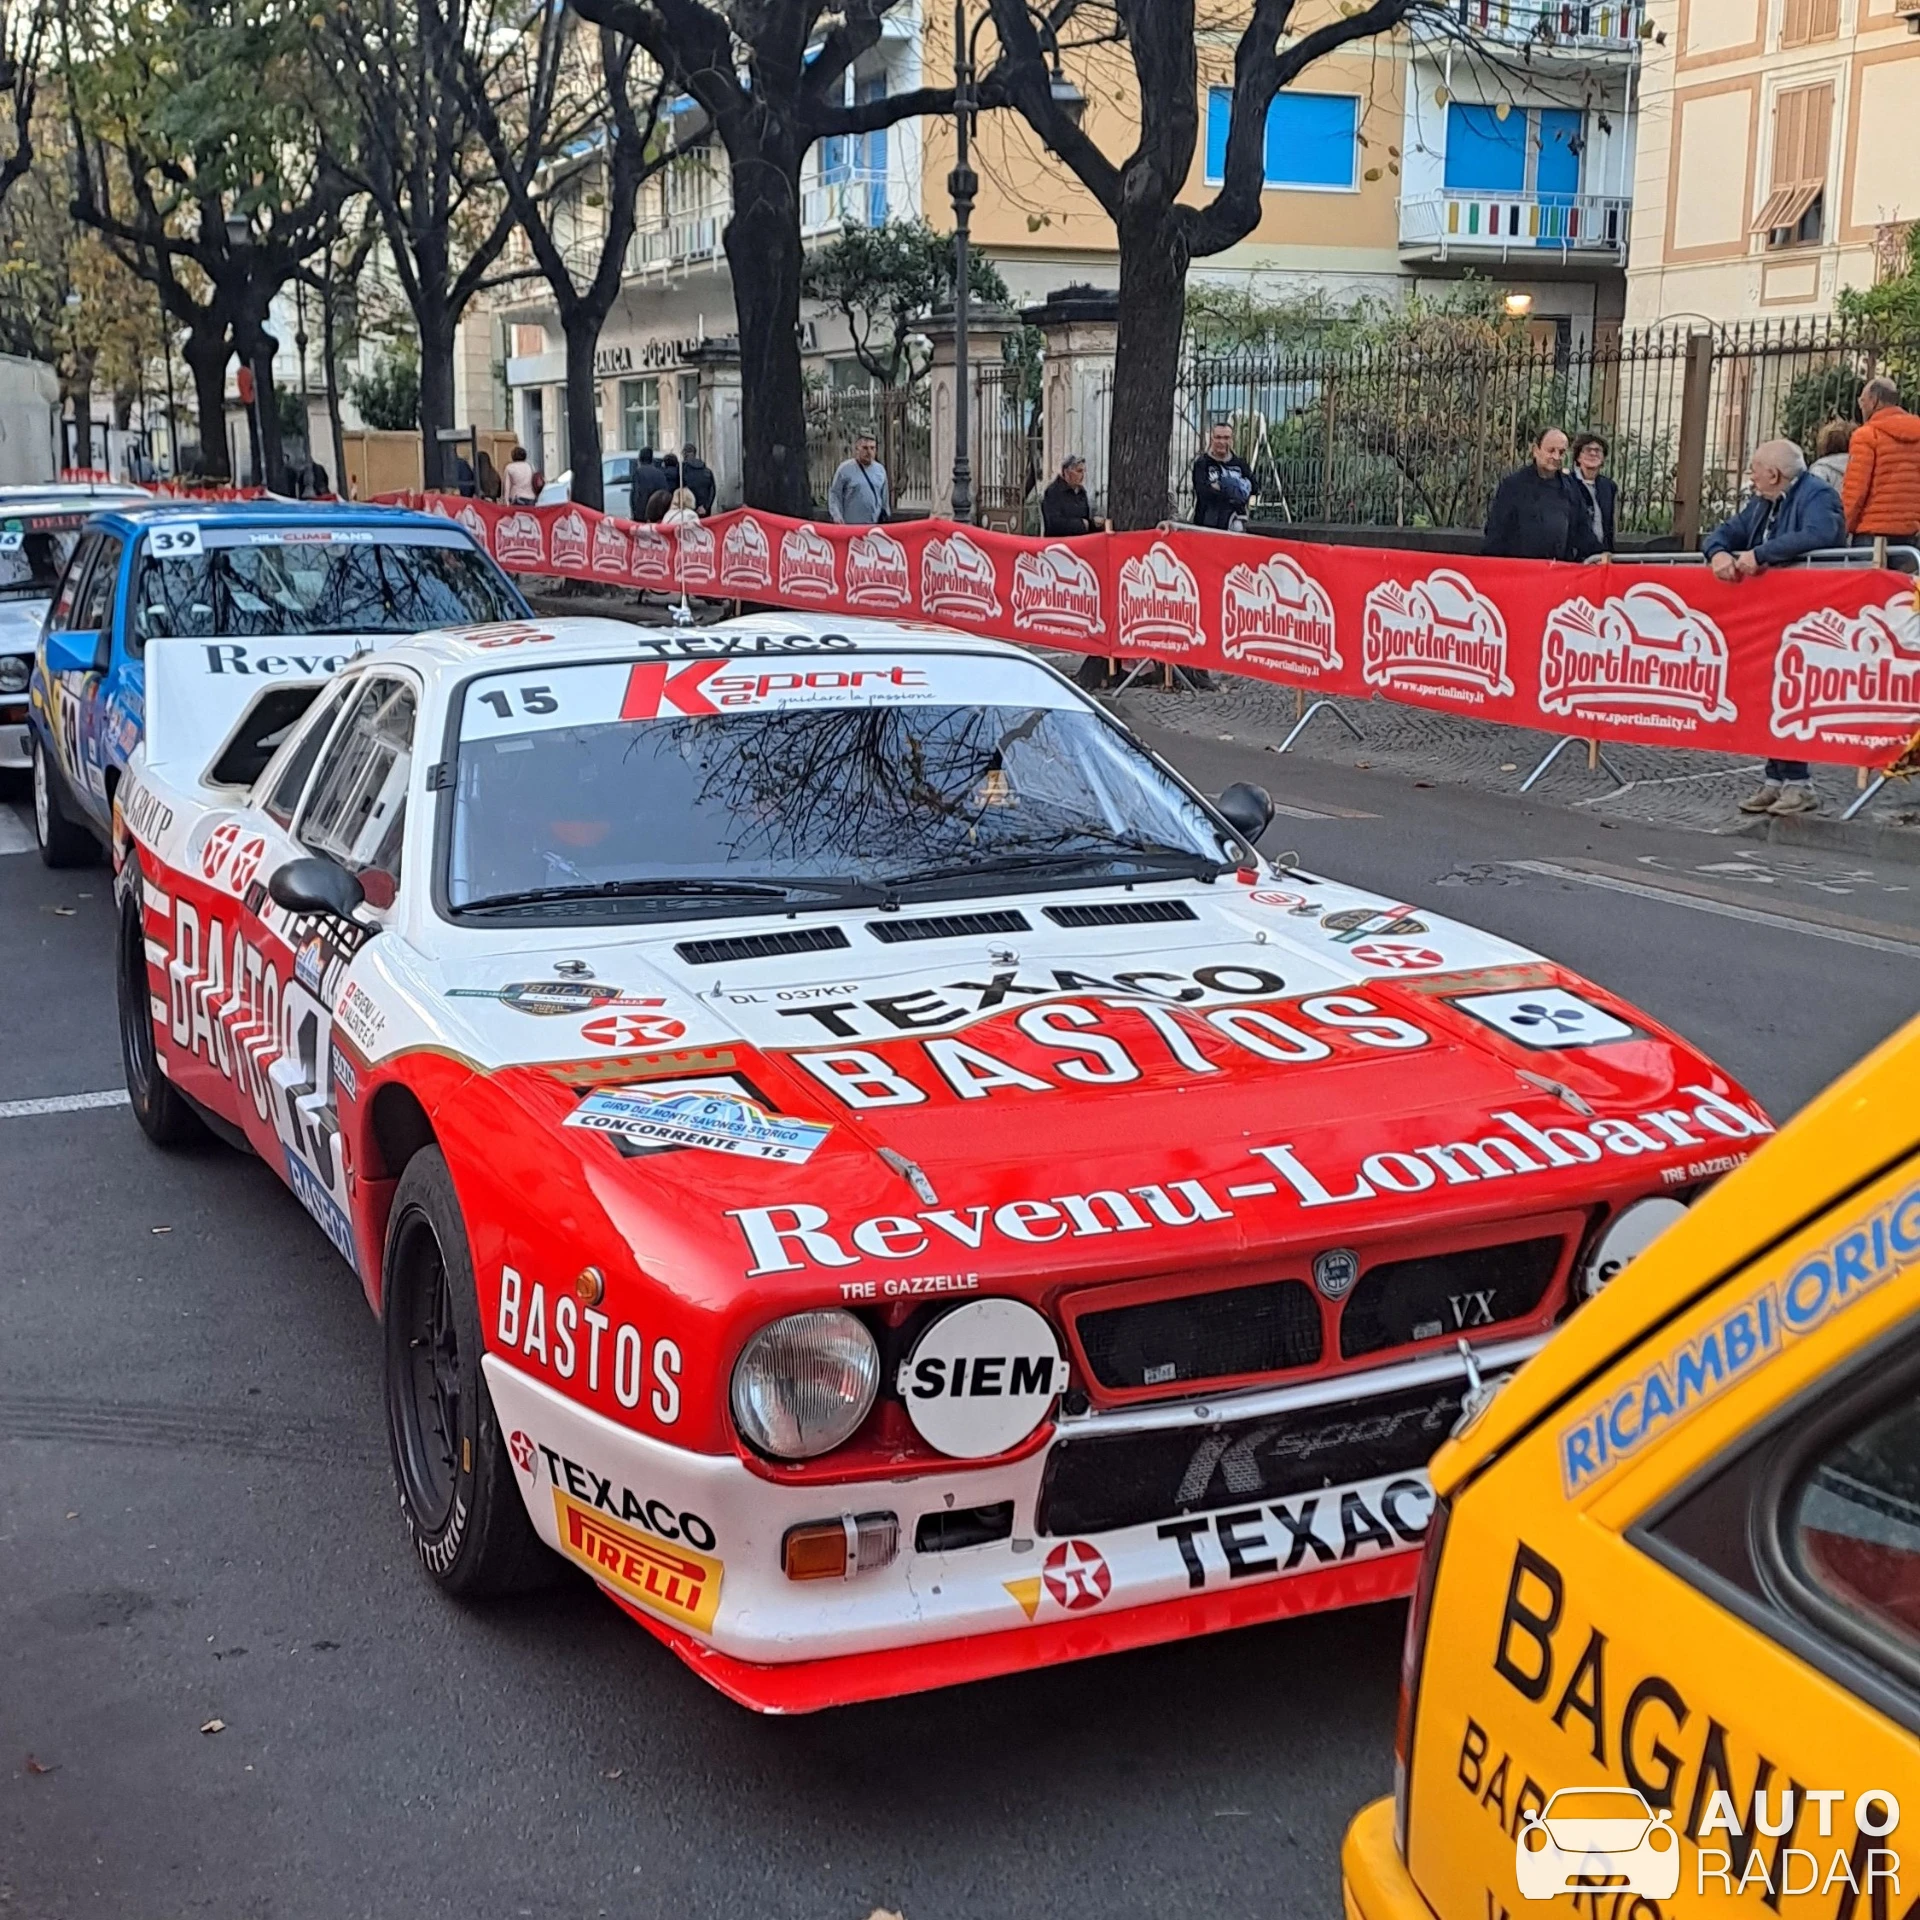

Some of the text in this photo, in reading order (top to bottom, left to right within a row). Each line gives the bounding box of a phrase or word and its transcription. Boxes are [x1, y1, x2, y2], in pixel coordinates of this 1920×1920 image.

[593, 346, 633, 372] ANCA
[154, 531, 197, 550] 39
[1014, 571, 1098, 629] SportInfinity
[1121, 582, 1197, 640] SportInfinity
[638, 633, 858, 656] TEXACO
[1225, 588, 1332, 663] SportInfinity
[1368, 608, 1503, 688] SportInfinity
[1393, 679, 1485, 704] www.sportinfinity.it
[1545, 629, 1722, 713] SportInfinity
[477, 686, 560, 719] 15
[778, 689, 938, 711] guidare la passione
[1576, 708, 1698, 732] www.sportinfinity.it
[129, 785, 174, 848] GROUP
[729, 984, 860, 1005] DL 037KP
[775, 964, 1288, 1039] TEXACO
[792, 994, 1431, 1111] BASTOS
[601, 1100, 629, 1112] GIRO
[632, 1104, 651, 1115] DEI
[653, 1108, 688, 1123] MONTI
[690, 1115, 747, 1133] SAVONESI
[748, 1124, 800, 1141] STORICO
[703, 1101, 720, 1115] 6
[580, 1114, 741, 1151] CONCORRENTE
[760, 1145, 791, 1159] 15
[724, 1084, 1778, 1279] Revenu-Lombard
[1660, 1167, 1686, 1184] TRE
[840, 1273, 980, 1299] TRE GAZZELLE
[1448, 1289, 1497, 1329] VX
[498, 1264, 683, 1425] BASTOS
[910, 1355, 1055, 1400] SIEM
[1565, 1296, 1771, 1486] RICAMBI
[539, 1443, 717, 1552] TEXACO
[565, 1503, 707, 1613] PIRELLI
